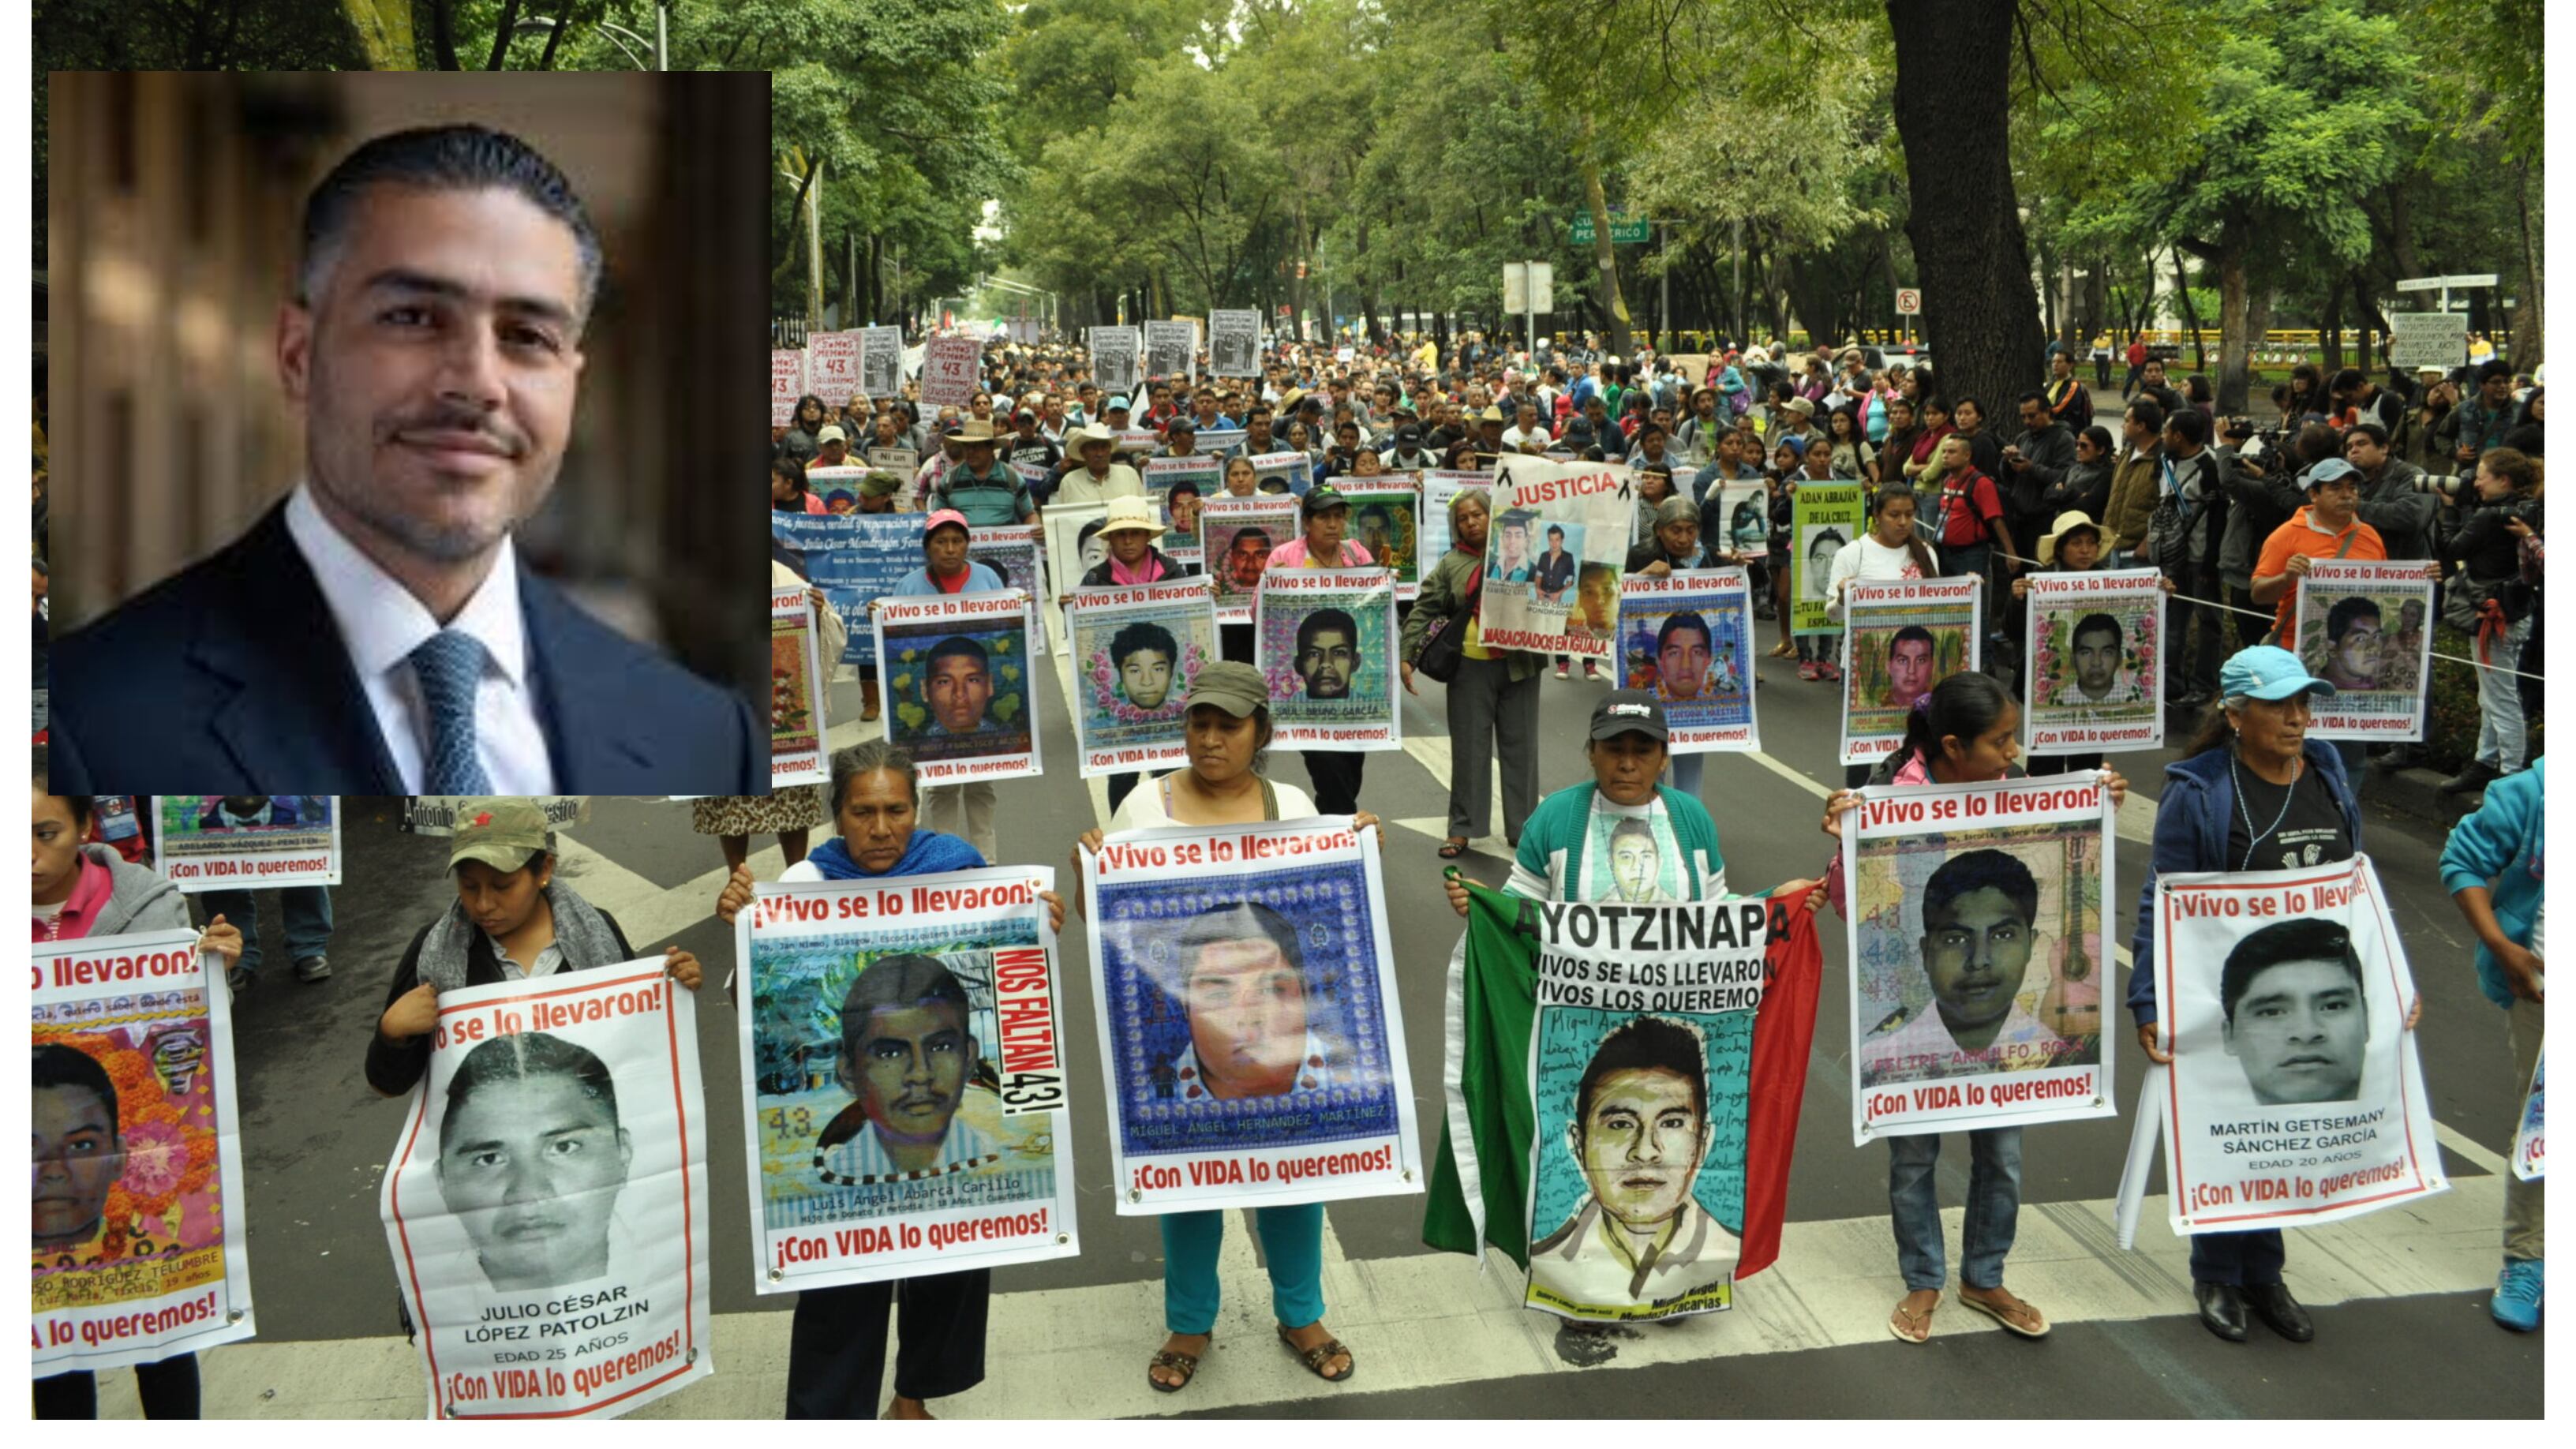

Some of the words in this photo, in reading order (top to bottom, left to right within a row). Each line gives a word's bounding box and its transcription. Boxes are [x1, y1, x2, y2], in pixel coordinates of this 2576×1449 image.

[826, 358, 846, 374] 43
[942, 362, 961, 376] 43
[1511, 471, 1618, 507] JUSTICIA
[1809, 512, 1819, 523] DE
[1821, 512, 1831, 523] LA
[1831, 511, 1852, 522] CRUZ
[1265, 576, 1299, 590] ¡Vivo
[1303, 578, 1316, 588] se
[1320, 576, 1331, 587] lo
[1672, 578, 1685, 590] lo
[2035, 578, 2068, 593] ¡Vivo
[2072, 579, 2085, 591] se
[2088, 578, 2100, 590] lo
[2102, 576, 2156, 590] llevaron!
[2308, 566, 2341, 579] ¡Vivo
[2345, 568, 2357, 578] se
[2361, 566, 2372, 578] lo
[1074, 594, 1110, 610] ¡Vivo
[1114, 593, 1129, 604] se
[1133, 590, 1145, 601] lo
[1853, 587, 1884, 601] ¡Vivo
[1888, 587, 1901, 598] se
[1904, 586, 1915, 598] lo
[883, 601, 921, 621] ¡Vivo
[924, 603, 942, 616] se
[947, 599, 957, 615] lo
[1484, 628, 1555, 652] MASACRADOS
[1555, 636, 1568, 651] EN
[1333, 728, 1388, 742] queremos!
[2035, 732, 2057, 744] ¡Con
[2061, 730, 2085, 743] VIDA
[2087, 729, 2097, 741] lo
[2099, 726, 2151, 743] queremos!
[2322, 717, 2345, 729] VIDA
[2348, 717, 2357, 728] lo
[2360, 717, 2410, 730] queremos!
[1118, 750, 1144, 763] VIDA
[924, 764, 953, 779] VIDA
[404, 797, 456, 828] Antonio
[1860, 799, 1925, 829] ¡Vivo
[1932, 798, 1957, 820] se
[1965, 793, 1987, 817] lo
[1995, 784, 2100, 814] llevaron!
[170, 863, 199, 879] ¡Con
[204, 861, 237, 876] VIDA
[242, 860, 253, 874] lo
[258, 856, 328, 876] queremos!
[1098, 844, 1167, 875] ¡Vivo
[1174, 844, 1203, 865] se
[1209, 837, 1234, 863] lo
[754, 893, 829, 929] ¡Vivo
[838, 897, 869, 919] se
[876, 889, 904, 915] lo
[912, 879, 1035, 915] llevaron!
[2173, 893, 2240, 921] ¡Vivo
[2248, 895, 2277, 917] se
[2285, 889, 2308, 915] lo
[953, 926, 979, 938] saber
[1513, 898, 1791, 951] AYOTZINAPA
[994, 949, 1048, 993] NOS
[1530, 951, 1590, 981] VIVOS
[1596, 961, 1623, 984] SE
[1627, 962, 1668, 987] LOS
[1672, 956, 1777, 987] LLEVARON
[1601, 987, 1645, 1011] LOS
[454, 1017, 484, 1044] se
[495, 1009, 522, 1037] lo
[532, 982, 662, 1033] llevaron!
[999, 996, 1055, 1073] FALTAN
[1874, 1053, 1940, 1073] FELIPE
[1002, 1073, 1064, 1114] 43!
[1867, 1092, 1907, 1121] ¡Con
[1913, 1086, 1962, 1110] VIDA
[1967, 1083, 1985, 1106] lo
[1990, 1073, 2091, 1107] queremos!
[767, 1106, 812, 1140] 43
[1130, 1123, 1180, 1137] MIGUEL
[2209, 1119, 2280, 1137] MARTÍN
[2285, 1106, 2387, 1133] GETSEMANY
[2222, 1136, 2311, 1155] SÁNCHEZ
[2316, 1128, 2378, 1150] GARCÍA
[1133, 1164, 1181, 1191] ¡Con
[1188, 1158, 1245, 1187] VIDA
[1249, 1156, 1271, 1182] lo
[1276, 1144, 1393, 1185] queremos!
[2248, 1159, 2294, 1170] EDAD
[2299, 1155, 2318, 1167] 20
[2323, 1149, 2363, 1165] AÑOS
[812, 1199, 844, 1211] Luis
[904, 1185, 954, 1201] Abarca
[962, 1179, 1021, 1193] Carillo
[2190, 1181, 2233, 1212] ¡Con
[2240, 1175, 2290, 1203] VIDA
[2294, 1174, 2314, 1197] lo
[2319, 1155, 2406, 1200] queremos!
[827, 1212, 837, 1221] de
[841, 1207, 873, 1220] Donato
[777, 1235, 828, 1268] ¡Con
[834, 1225, 894, 1259] VIDA
[900, 1220, 922, 1249] lo
[927, 1207, 1049, 1249] queremos!
[152, 1252, 219, 1279] TELUMBRE
[167, 1278, 179, 1287] 19
[185, 1270, 212, 1282] años
[481, 1303, 541, 1322] JULIO
[546, 1286, 628, 1316] CÉSAR
[49, 1319, 75, 1347] lo
[81, 1291, 217, 1347] queremos!
[465, 1324, 530, 1344] LÓPEZ
[540, 1300, 650, 1339] PATOLZIN
[494, 1350, 541, 1365] EDAD
[545, 1348, 567, 1361] 25
[575, 1331, 630, 1356] AÑOS
[446, 1372, 488, 1407] ¡Con
[493, 1368, 541, 1398] VIDA
[545, 1367, 566, 1397] lo
[573, 1328, 680, 1398] queremos!
